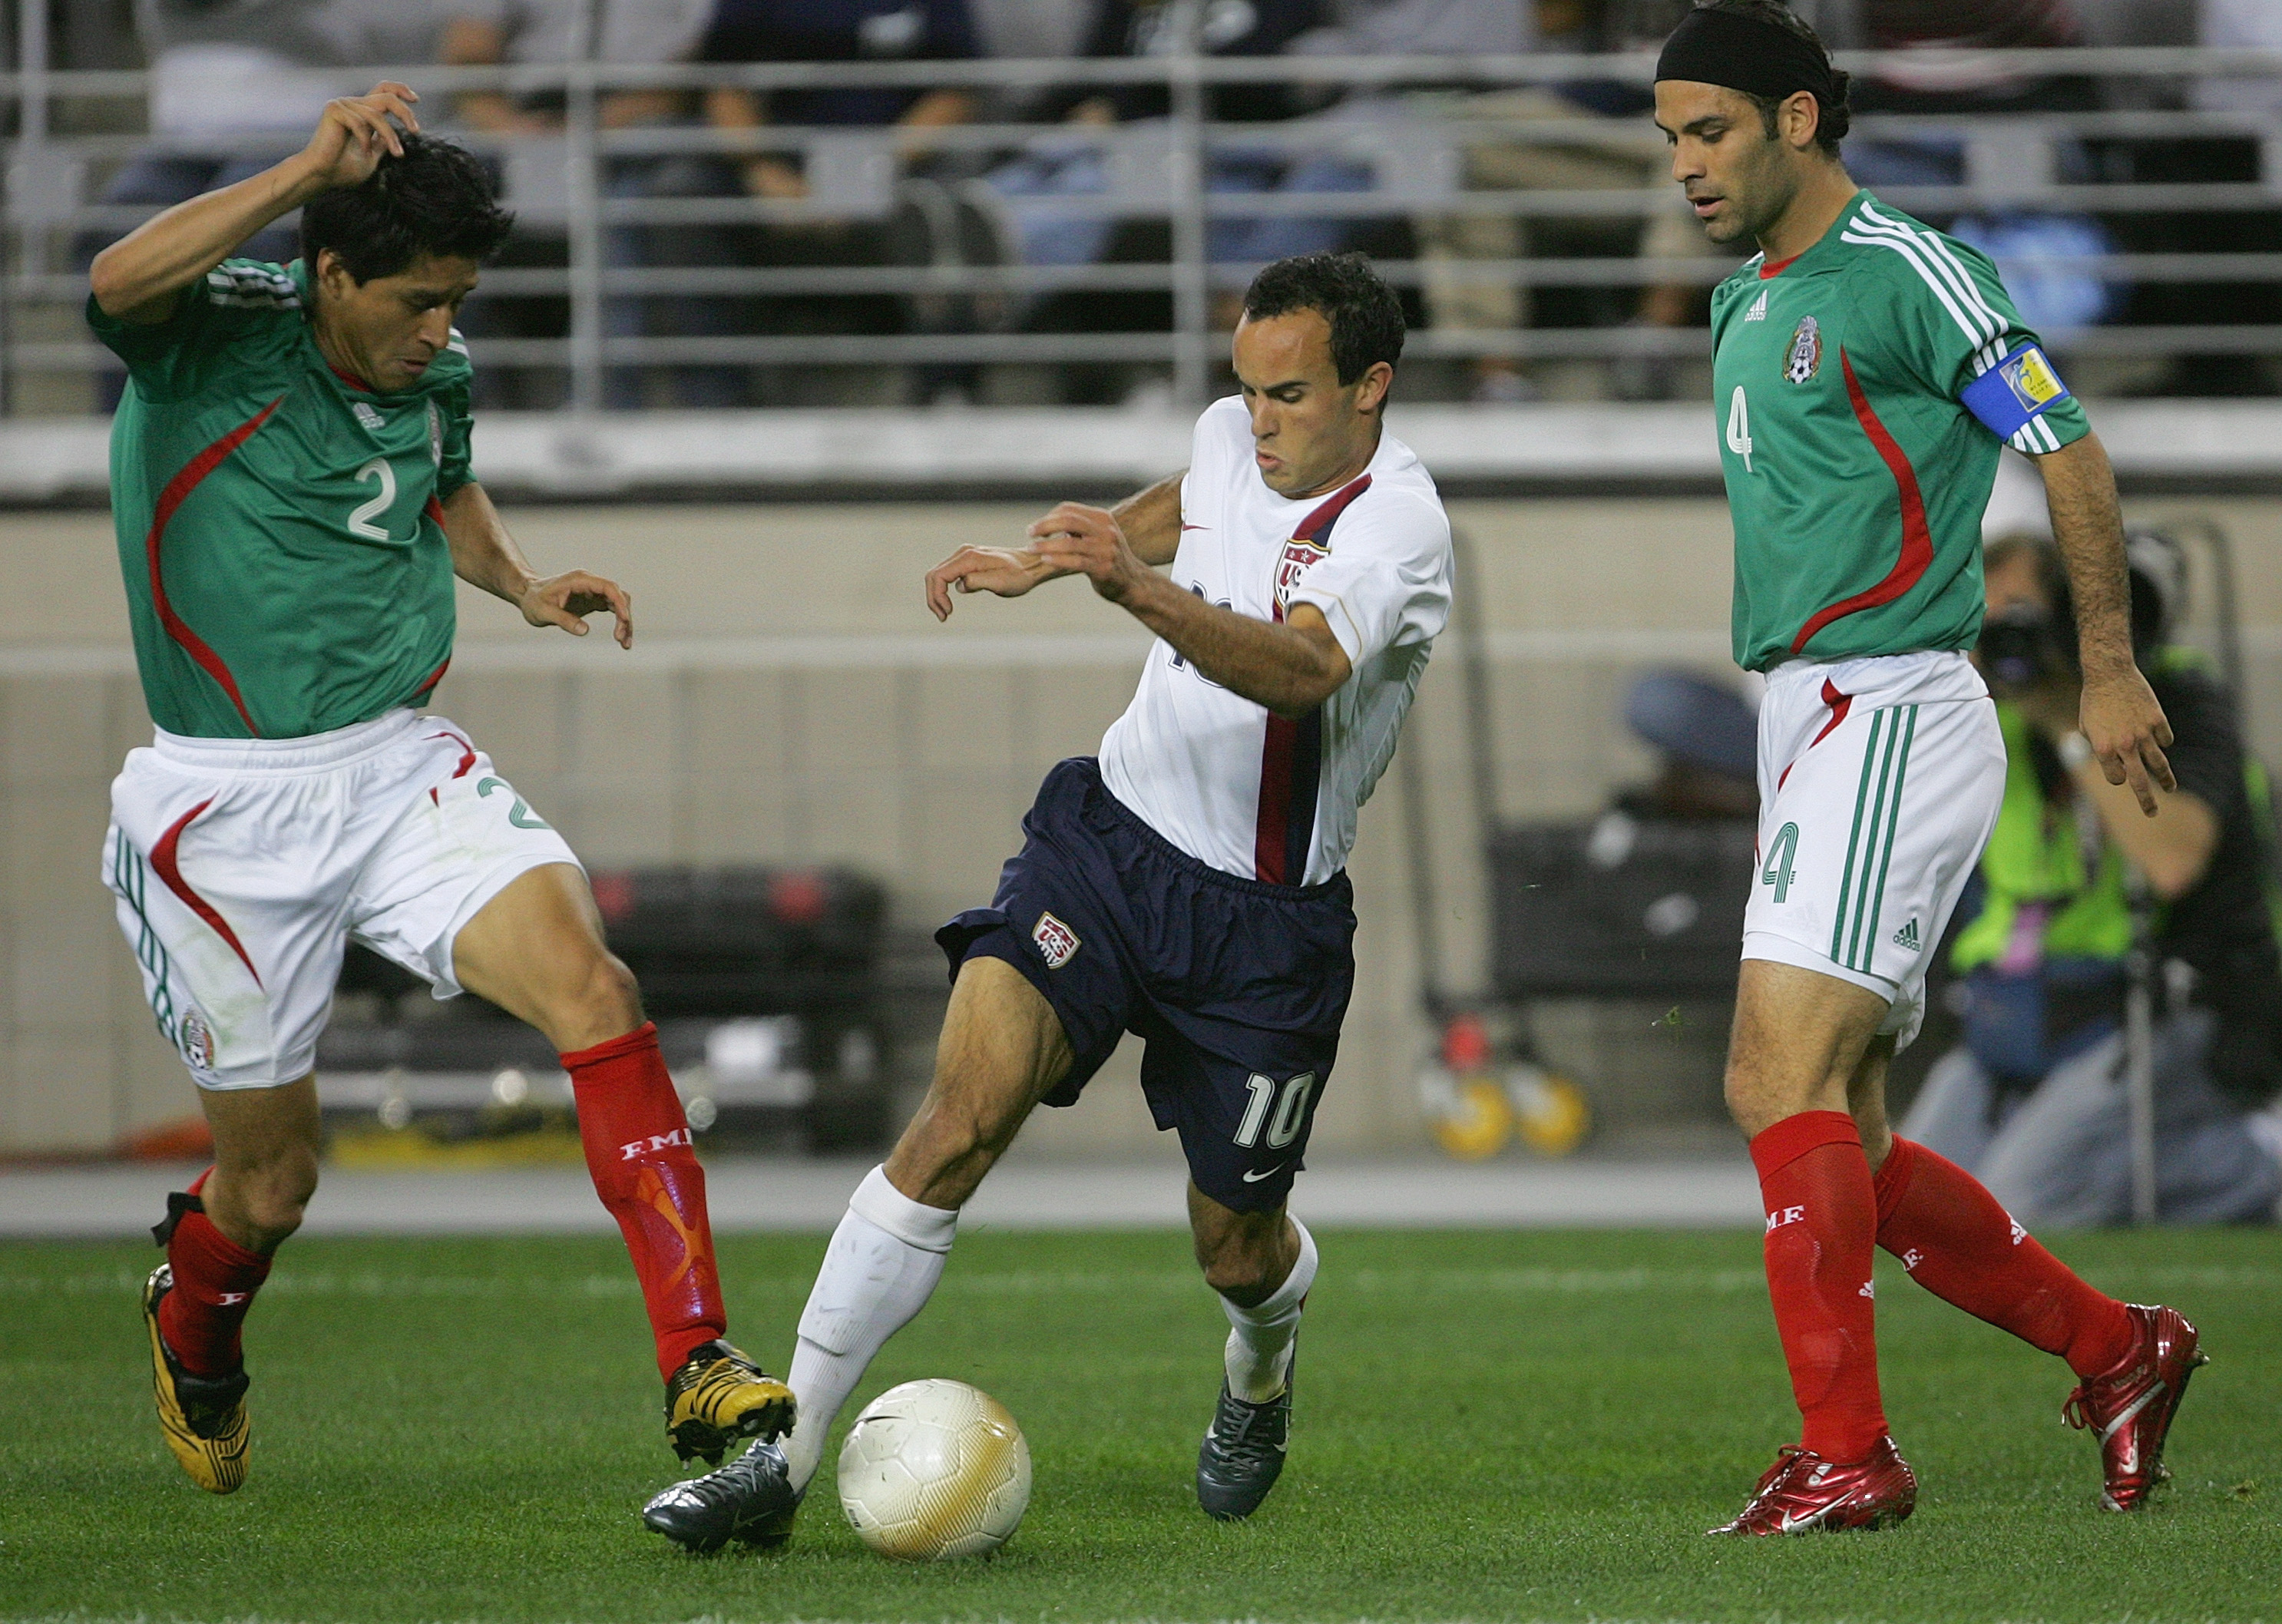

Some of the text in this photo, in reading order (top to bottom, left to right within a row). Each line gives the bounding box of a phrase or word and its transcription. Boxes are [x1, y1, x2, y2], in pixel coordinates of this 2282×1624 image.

[1726, 385, 1753, 472] 4
[348, 458, 396, 541] 2
[1280, 563, 1299, 587] U
[476, 776, 556, 829] 2
[1761, 822, 1797, 904] 4
[1893, 934, 1921, 952] adidas
[1232, 1070, 1316, 1150] 10
